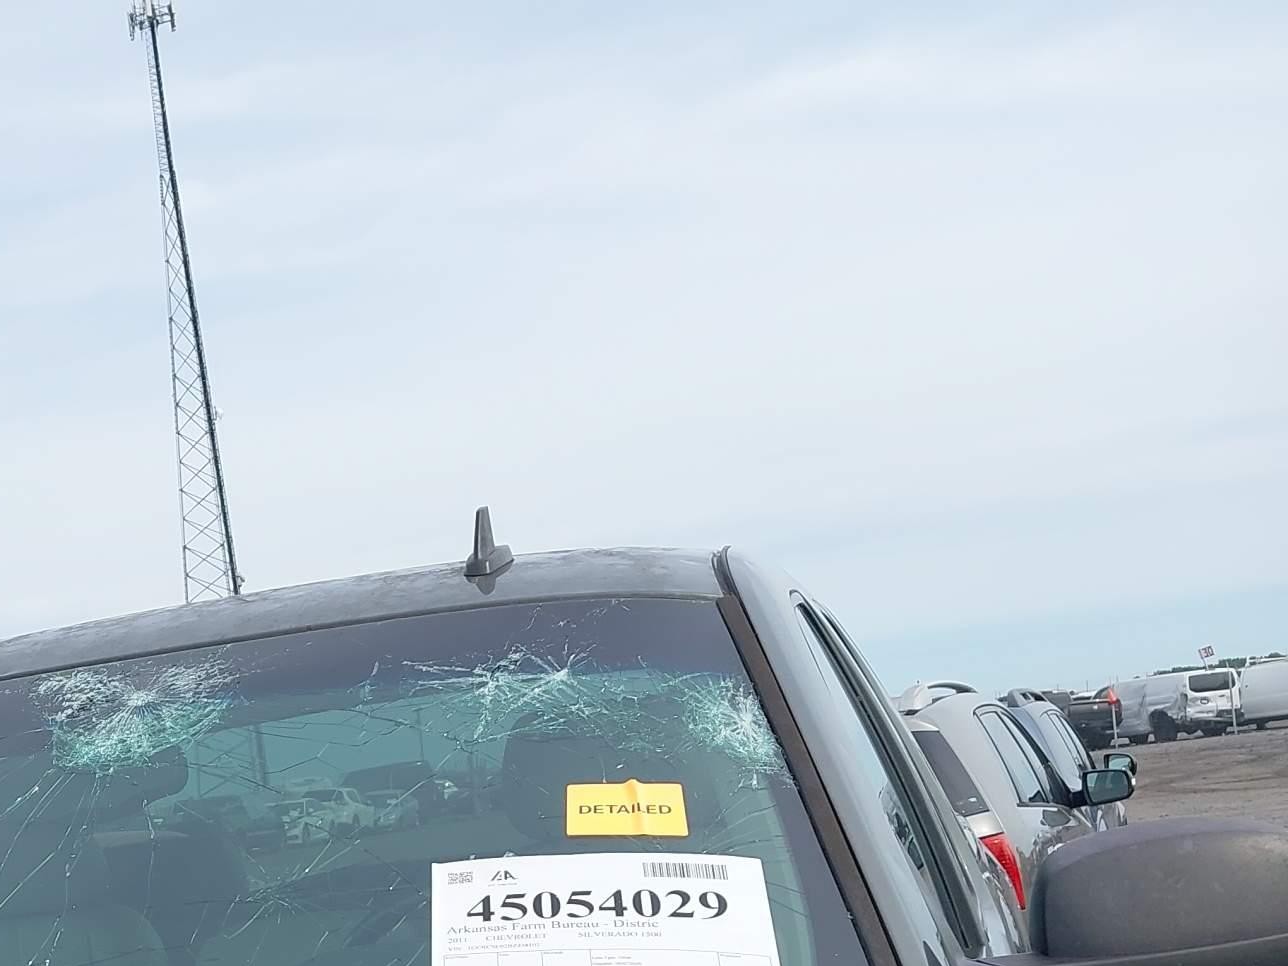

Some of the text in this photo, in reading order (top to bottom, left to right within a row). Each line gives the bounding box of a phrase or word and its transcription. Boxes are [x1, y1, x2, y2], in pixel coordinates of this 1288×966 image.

[578, 802, 672, 815] DETAILED
[466, 889, 728, 922] 45054029
[447, 925, 508, 935] Arkansas
[512, 922, 546, 931] Farm
[551, 920, 600, 929] Bureau
[613, 919, 660, 928] Distric
[485, 933, 547, 942] CHEVROLET
